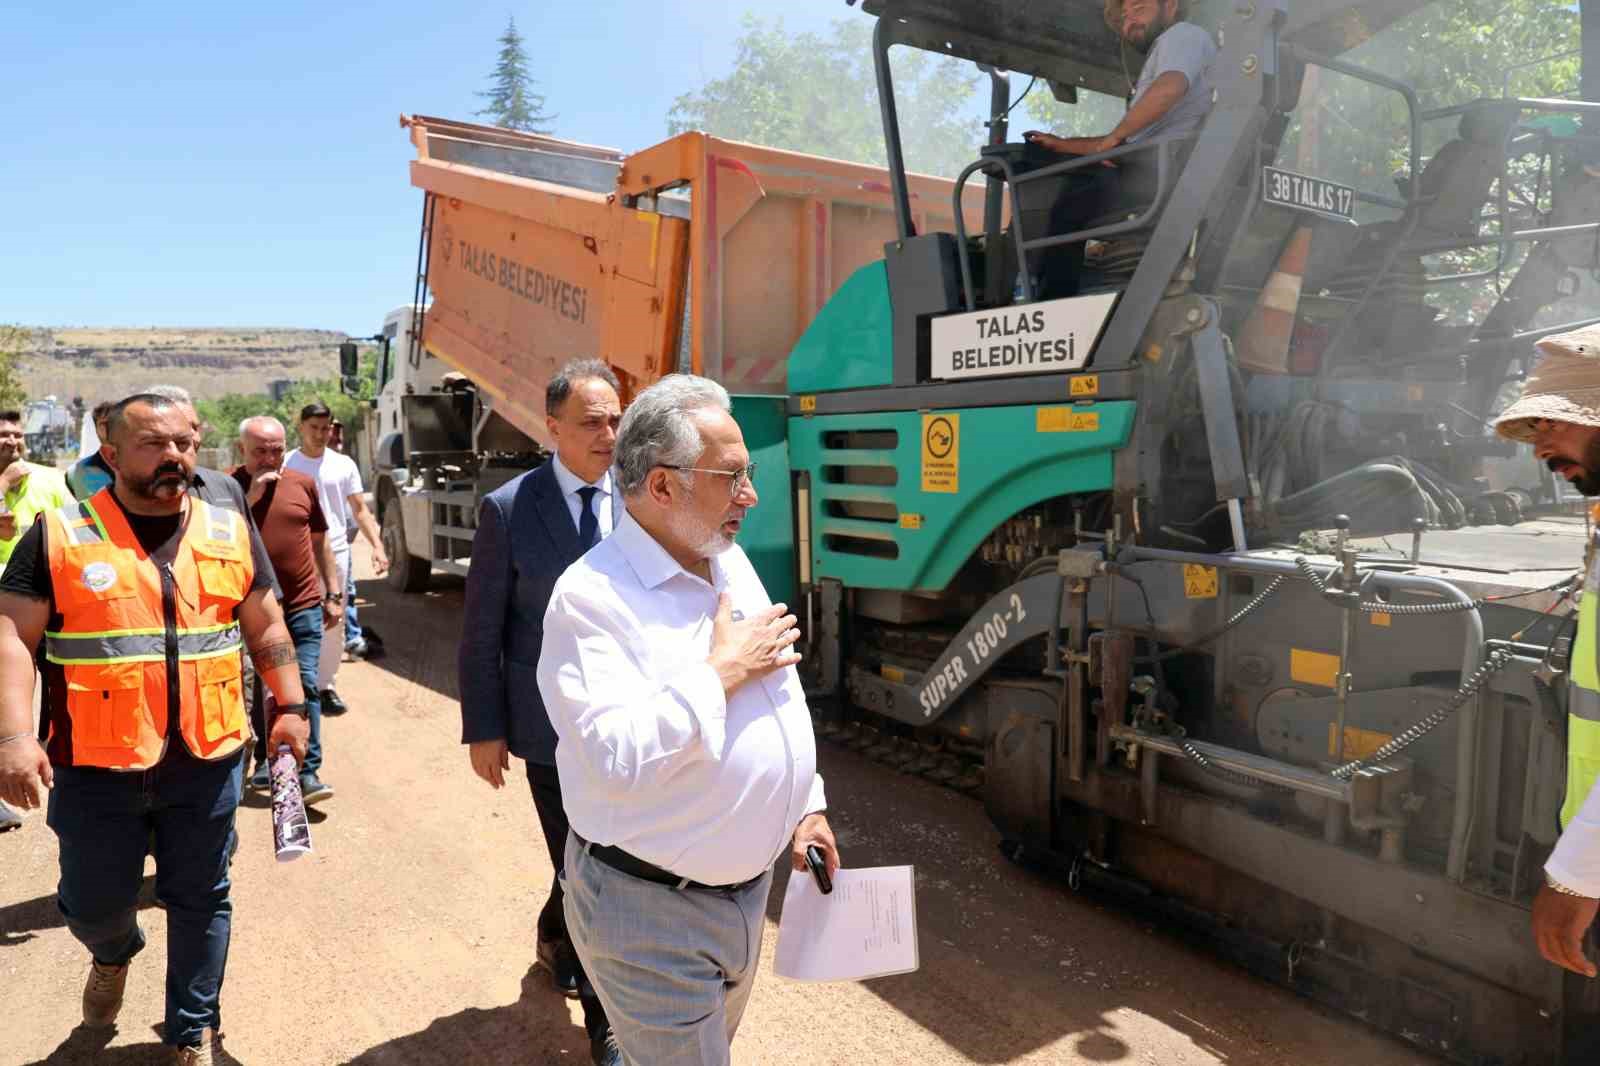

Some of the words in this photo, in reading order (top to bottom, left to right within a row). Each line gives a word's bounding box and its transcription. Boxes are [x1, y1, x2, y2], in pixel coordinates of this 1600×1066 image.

[1272, 173, 1290, 201] 38
[1292, 177, 1334, 210] TALAS
[1337, 188, 1352, 214] 17
[459, 239, 496, 283] TALAS
[498, 257, 588, 325] BELEDİYESİ
[976, 310, 1045, 339] TALAS
[952, 332, 1075, 371] BELEDİYESİ
[919, 655, 968, 717] SUPER
[967, 593, 1026, 665] 1800-2
